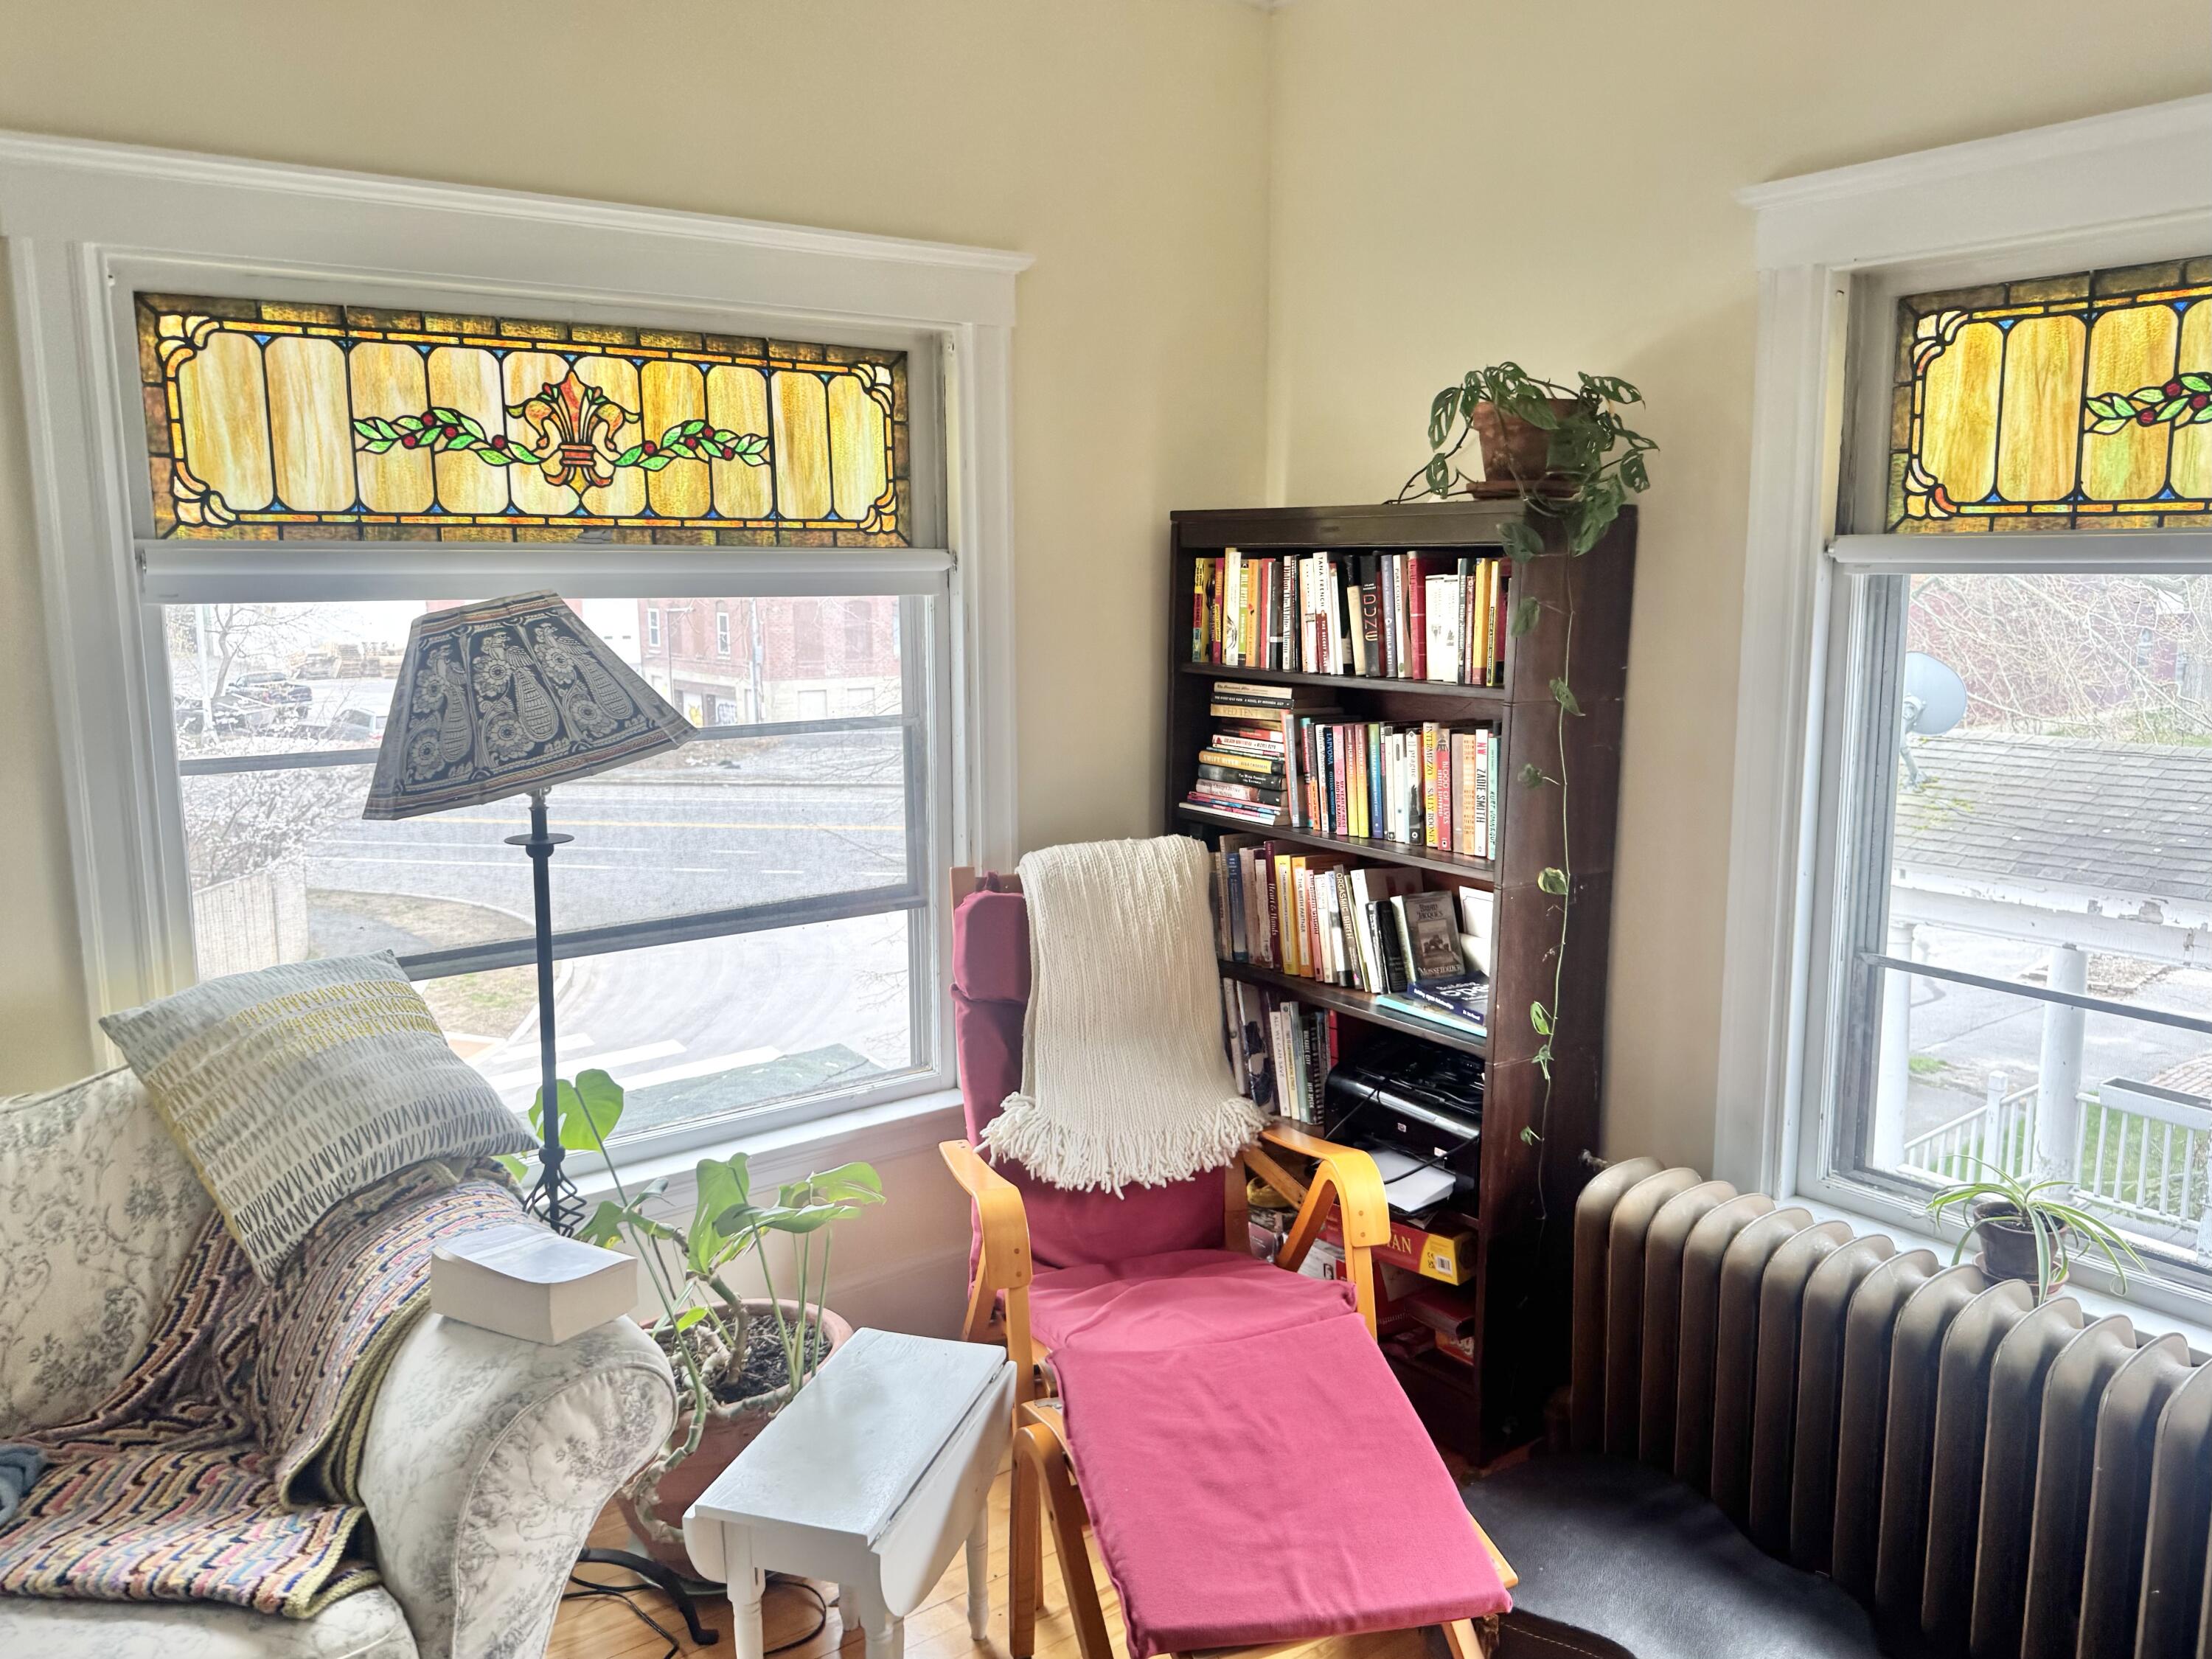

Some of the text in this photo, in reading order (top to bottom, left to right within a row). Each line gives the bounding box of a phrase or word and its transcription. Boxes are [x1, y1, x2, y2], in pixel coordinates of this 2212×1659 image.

[1240, 574, 1248, 587] BILL
[1340, 781, 1344, 790] MY
[1476, 742, 1486, 823] NW ZADIE SMITH
[1443, 790, 1449, 800] OF
[1336, 873, 1352, 939] ORGASMIC BIRTH
[1275, 1030, 1281, 1040] WE
